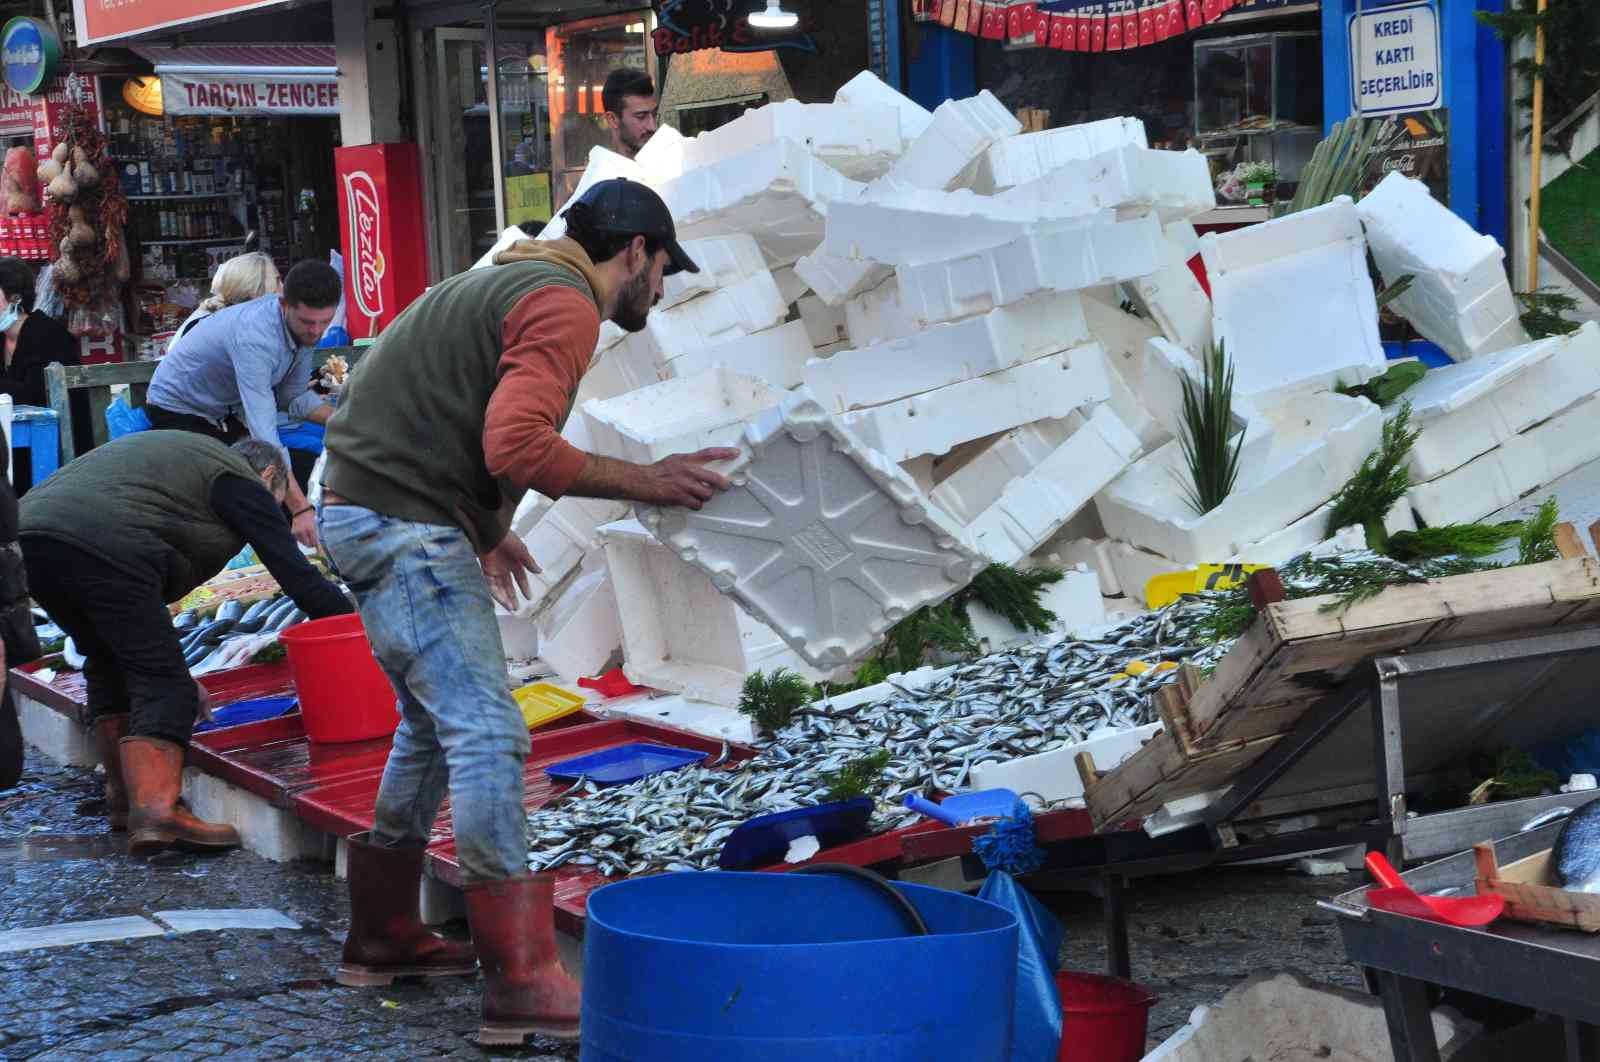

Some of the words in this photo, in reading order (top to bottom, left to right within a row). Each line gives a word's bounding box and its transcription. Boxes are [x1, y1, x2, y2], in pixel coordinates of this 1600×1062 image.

[1374, 15, 1413, 38] KREDİ
[1376, 46, 1415, 66] KARTI
[1360, 69, 1434, 97] GEÇERLİDİR
